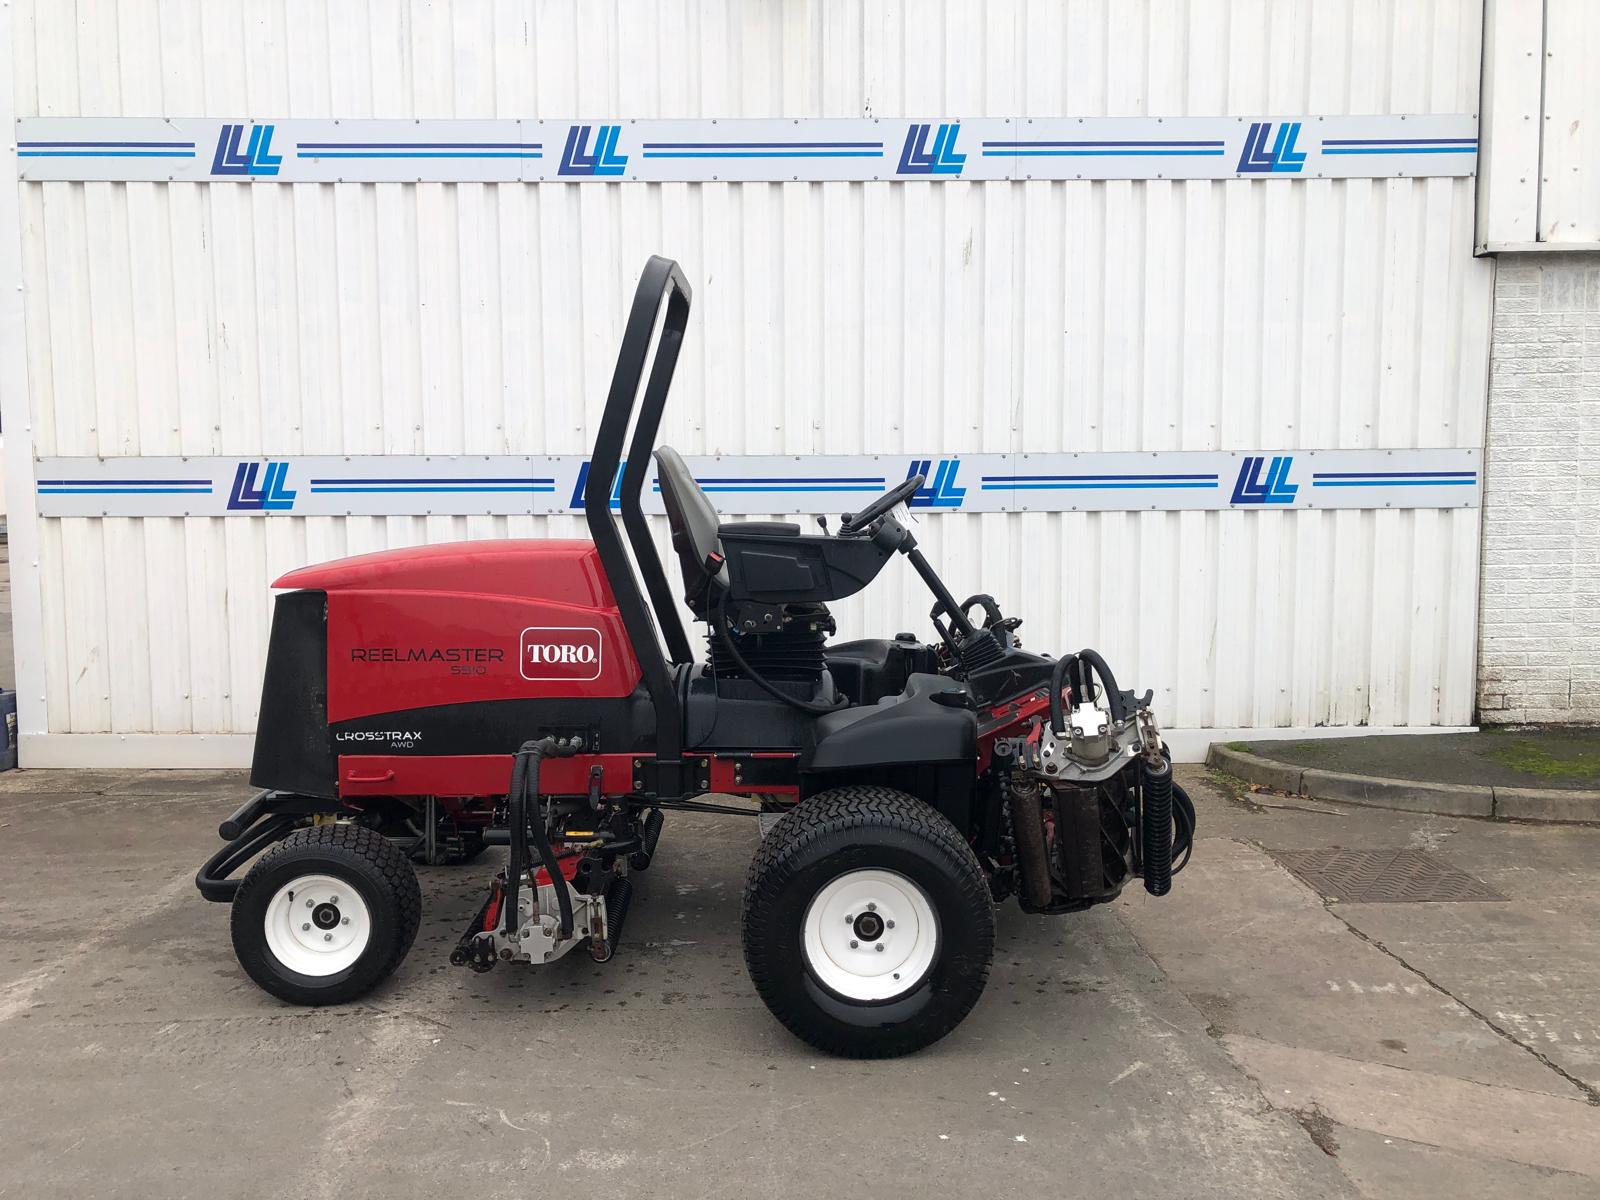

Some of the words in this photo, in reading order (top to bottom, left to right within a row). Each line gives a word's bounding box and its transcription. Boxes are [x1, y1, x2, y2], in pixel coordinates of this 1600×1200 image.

[351, 648, 504, 662] REELMASTER
[335, 731, 422, 741] CROSSTRAX
[390, 741, 414, 749] AWD
